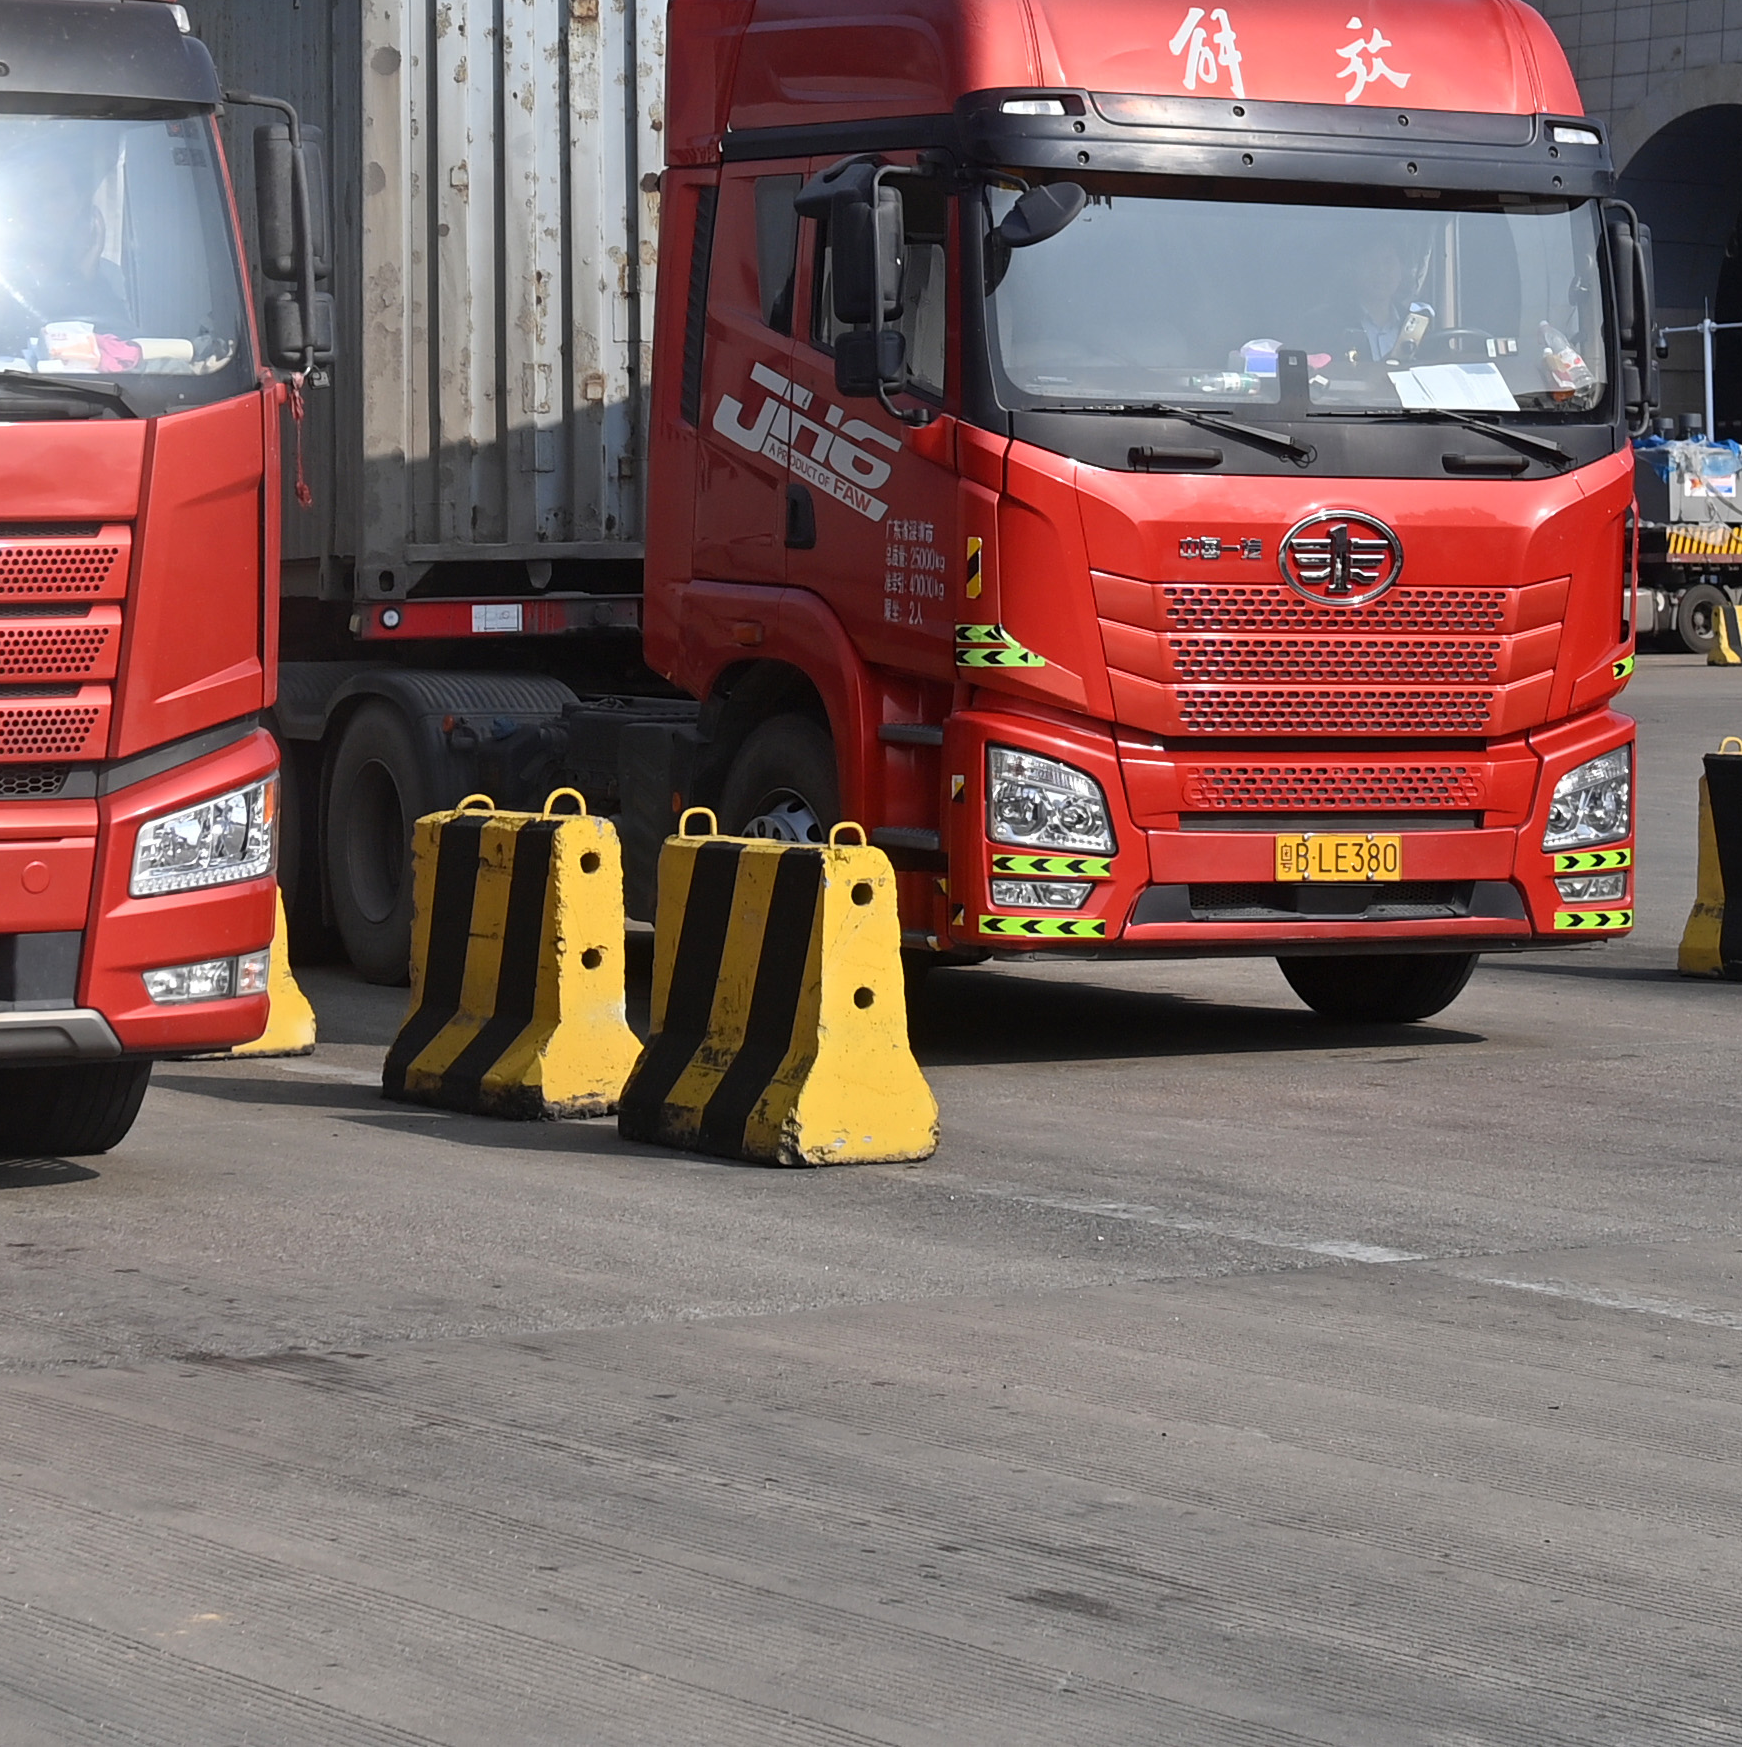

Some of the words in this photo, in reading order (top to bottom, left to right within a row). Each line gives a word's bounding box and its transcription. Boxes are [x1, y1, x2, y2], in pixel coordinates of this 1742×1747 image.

[1168, 7, 1411, 104] 解放
[817, 472, 831, 487] OF
[833, 477, 872, 513] FAW
